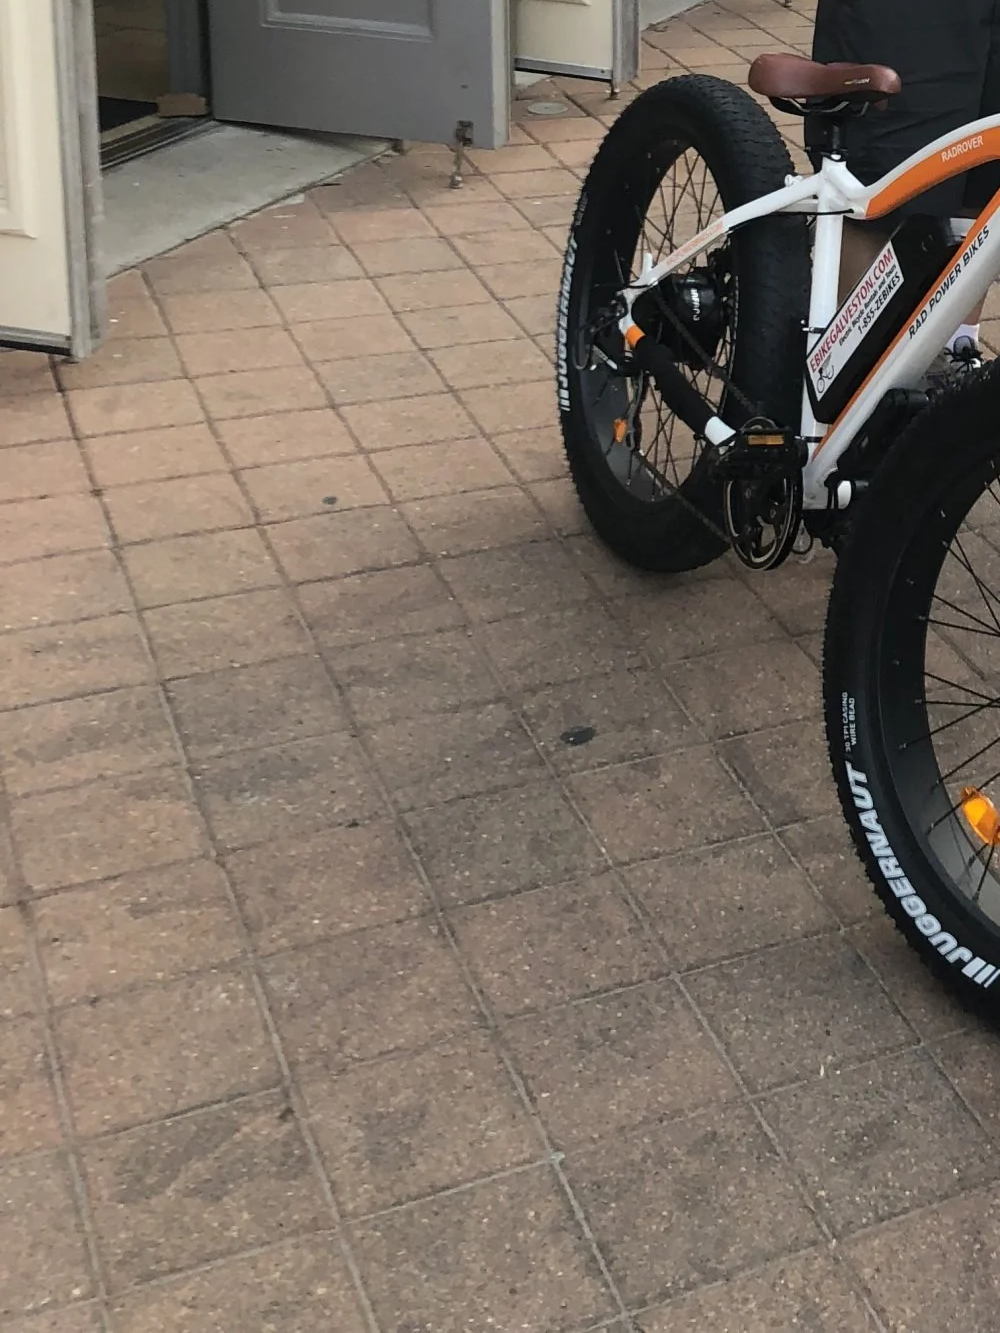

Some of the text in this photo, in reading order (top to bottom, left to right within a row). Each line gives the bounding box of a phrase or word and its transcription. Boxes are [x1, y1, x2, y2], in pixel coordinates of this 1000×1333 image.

[941, 136, 984, 163] RADROVER
[810, 248, 894, 373] EBIKEGALVESTON.COM
[858, 271, 900, 334] 1-855-ZEBIKES
[909, 225, 990, 339] RAD POWER BIKES
[846, 761, 975, 964] JUGGERNAUT
